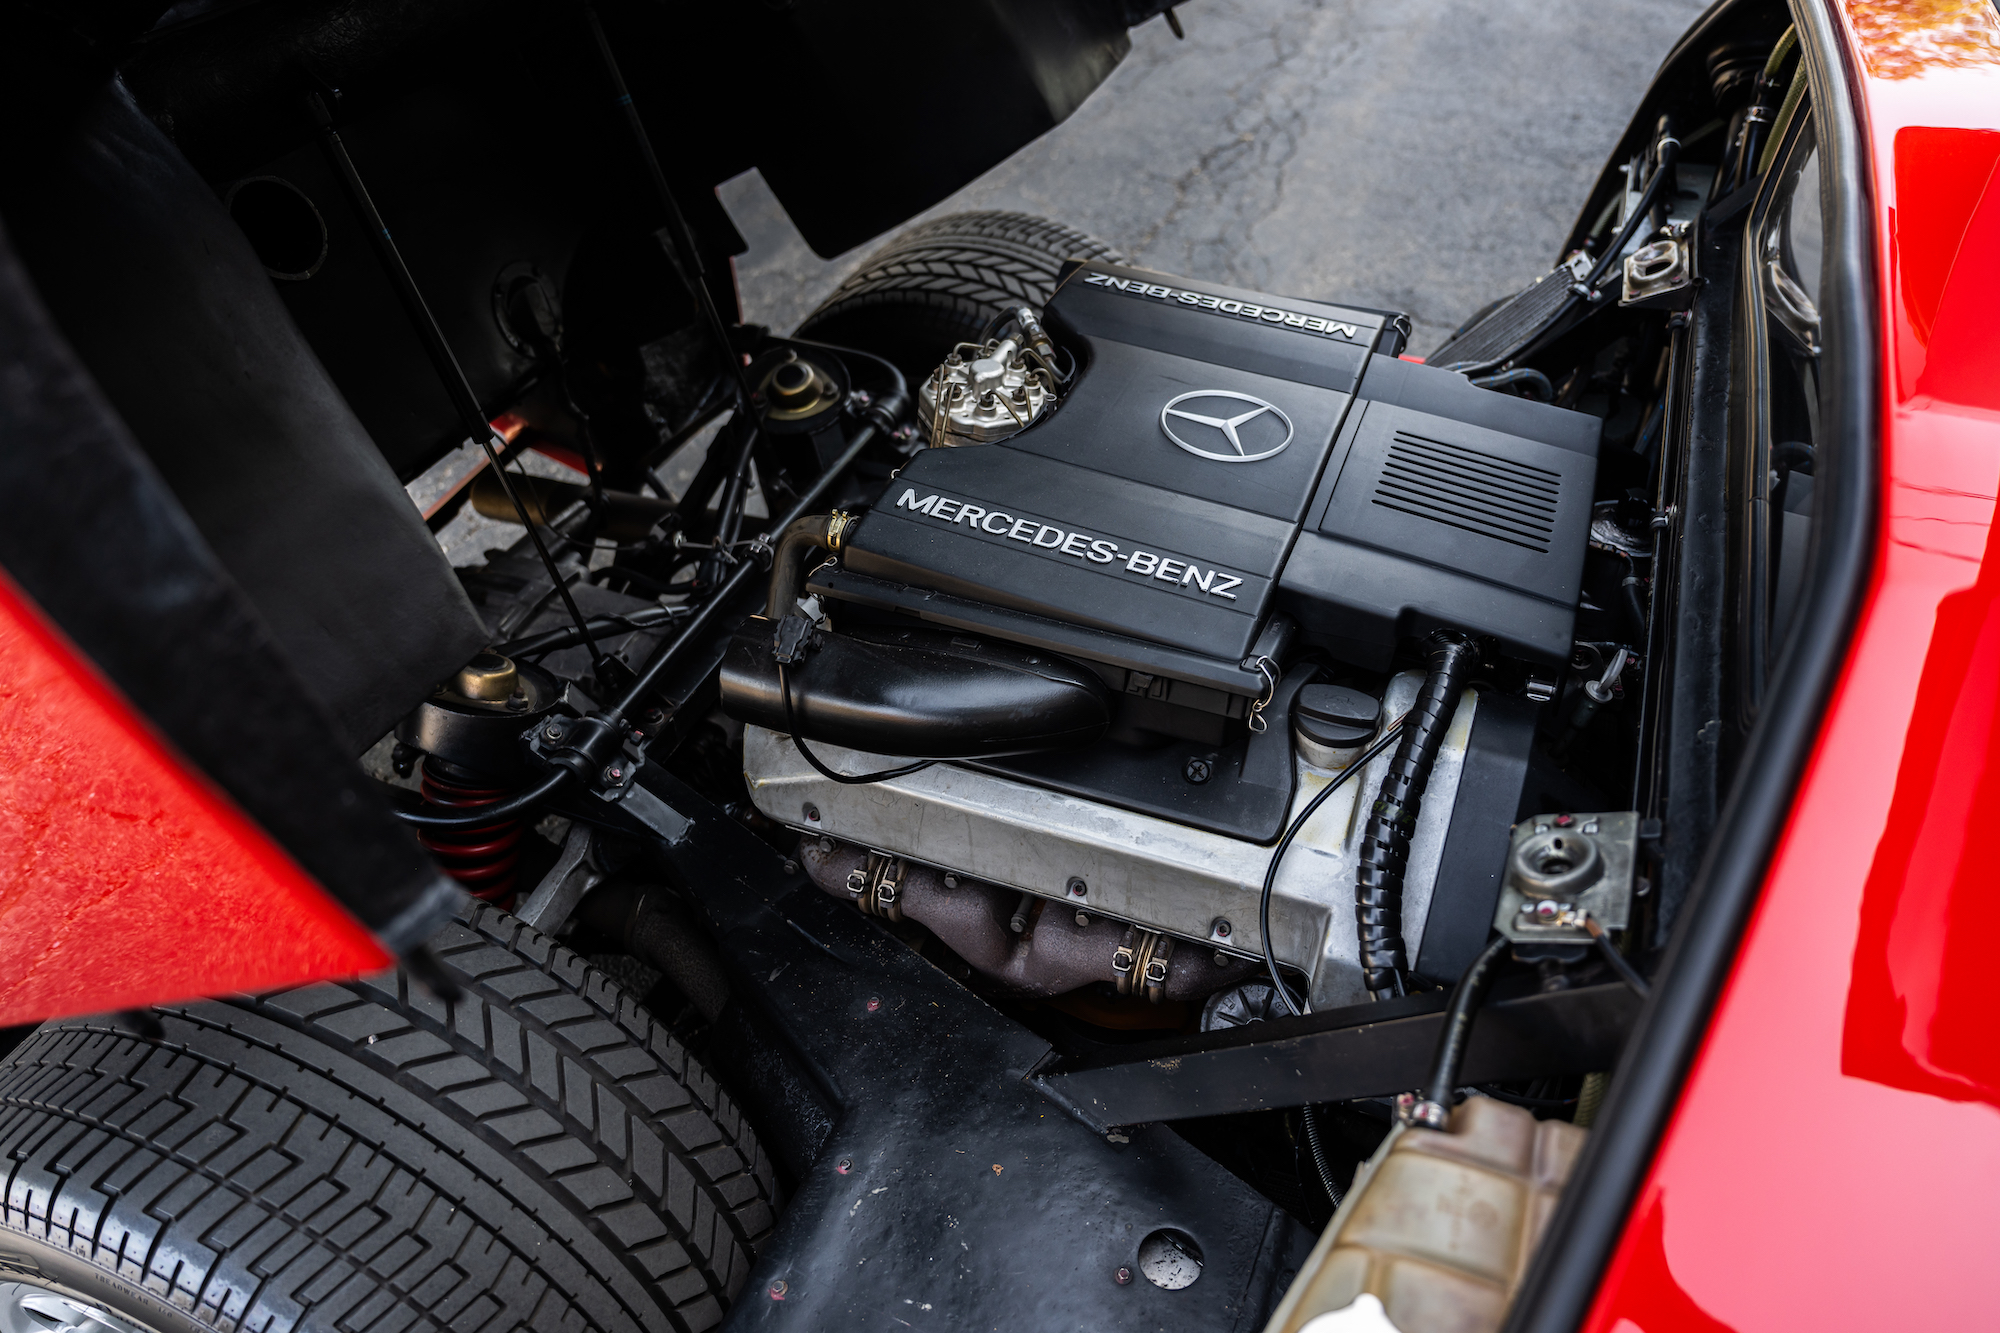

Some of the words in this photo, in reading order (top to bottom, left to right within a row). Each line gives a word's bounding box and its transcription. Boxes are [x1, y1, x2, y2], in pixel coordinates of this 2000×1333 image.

[1084, 273, 1357, 338] MERCEDES-BENZ
[896, 488, 1243, 600] MERCEDES-BENZ
[95, 1273, 149, 1305] TREADWEAR
